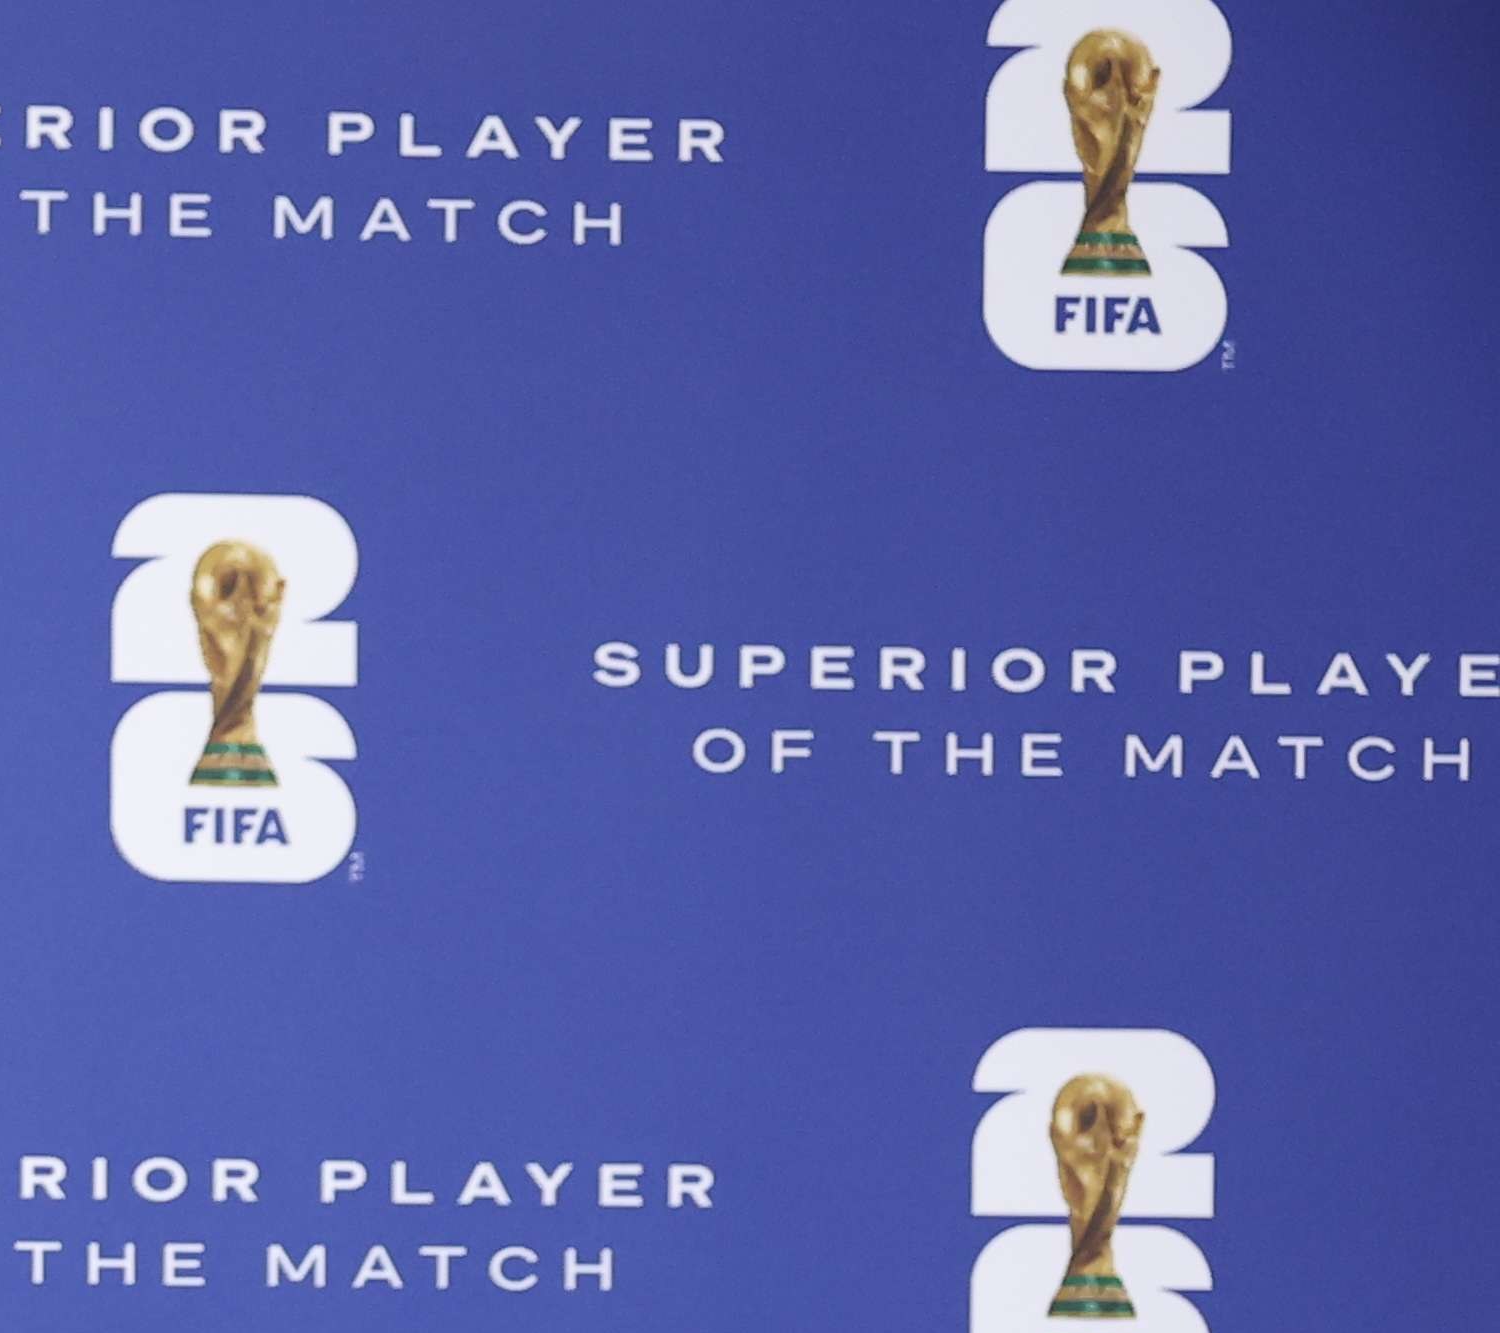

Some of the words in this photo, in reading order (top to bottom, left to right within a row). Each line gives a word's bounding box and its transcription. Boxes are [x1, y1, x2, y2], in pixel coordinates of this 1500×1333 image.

[327, 111, 725, 163] PLAYER
[19, 189, 213, 238] THE
[273, 195, 622, 246] MATCH
[1054, 296, 1161, 335] FIFA
[593, 641, 1117, 693] SUPERIOR
[1180, 651, 1500, 697] PLAYE
[692, 728, 814, 774] OF
[872, 730, 1064, 777] THE
[1124, 734, 1470, 782] MATCH
[184, 807, 286, 845] FIFA
[320, 1159, 715, 1208] PLAYER
[13, 1240, 206, 1287] THE
[266, 1243, 613, 1292] MATCH
